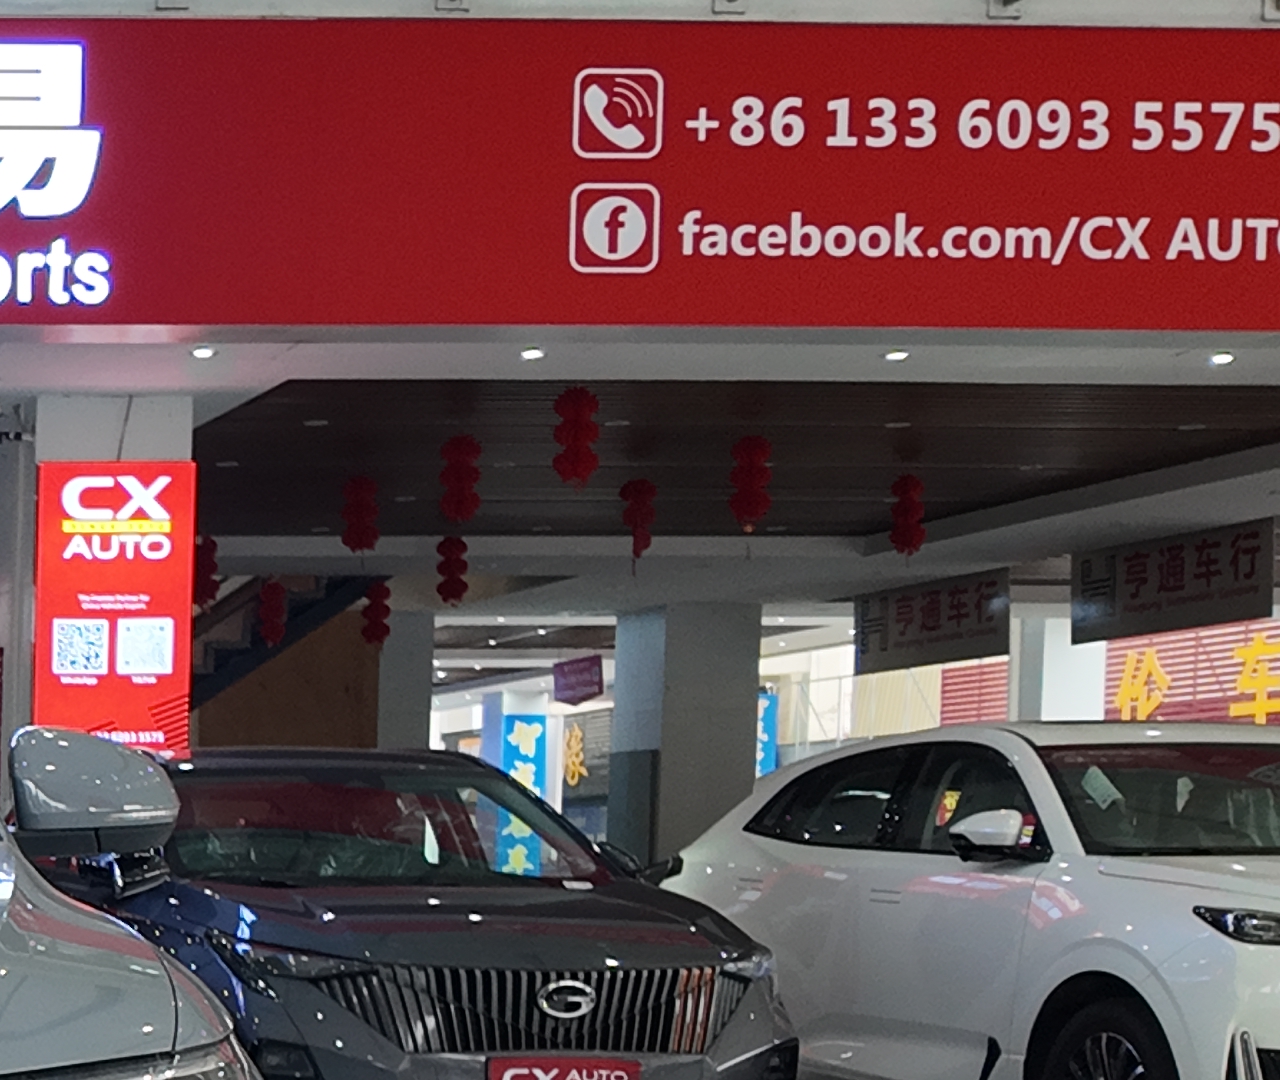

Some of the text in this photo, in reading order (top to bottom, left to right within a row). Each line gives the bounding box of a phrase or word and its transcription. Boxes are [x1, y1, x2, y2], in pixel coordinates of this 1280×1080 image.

[684, 96, 1280, 152] +86 133 6093 5575
[677, 209, 1280, 267] facebook.com/CX AUT
[61, 475, 172, 520] CX
[62, 534, 172, 560] AUTO
